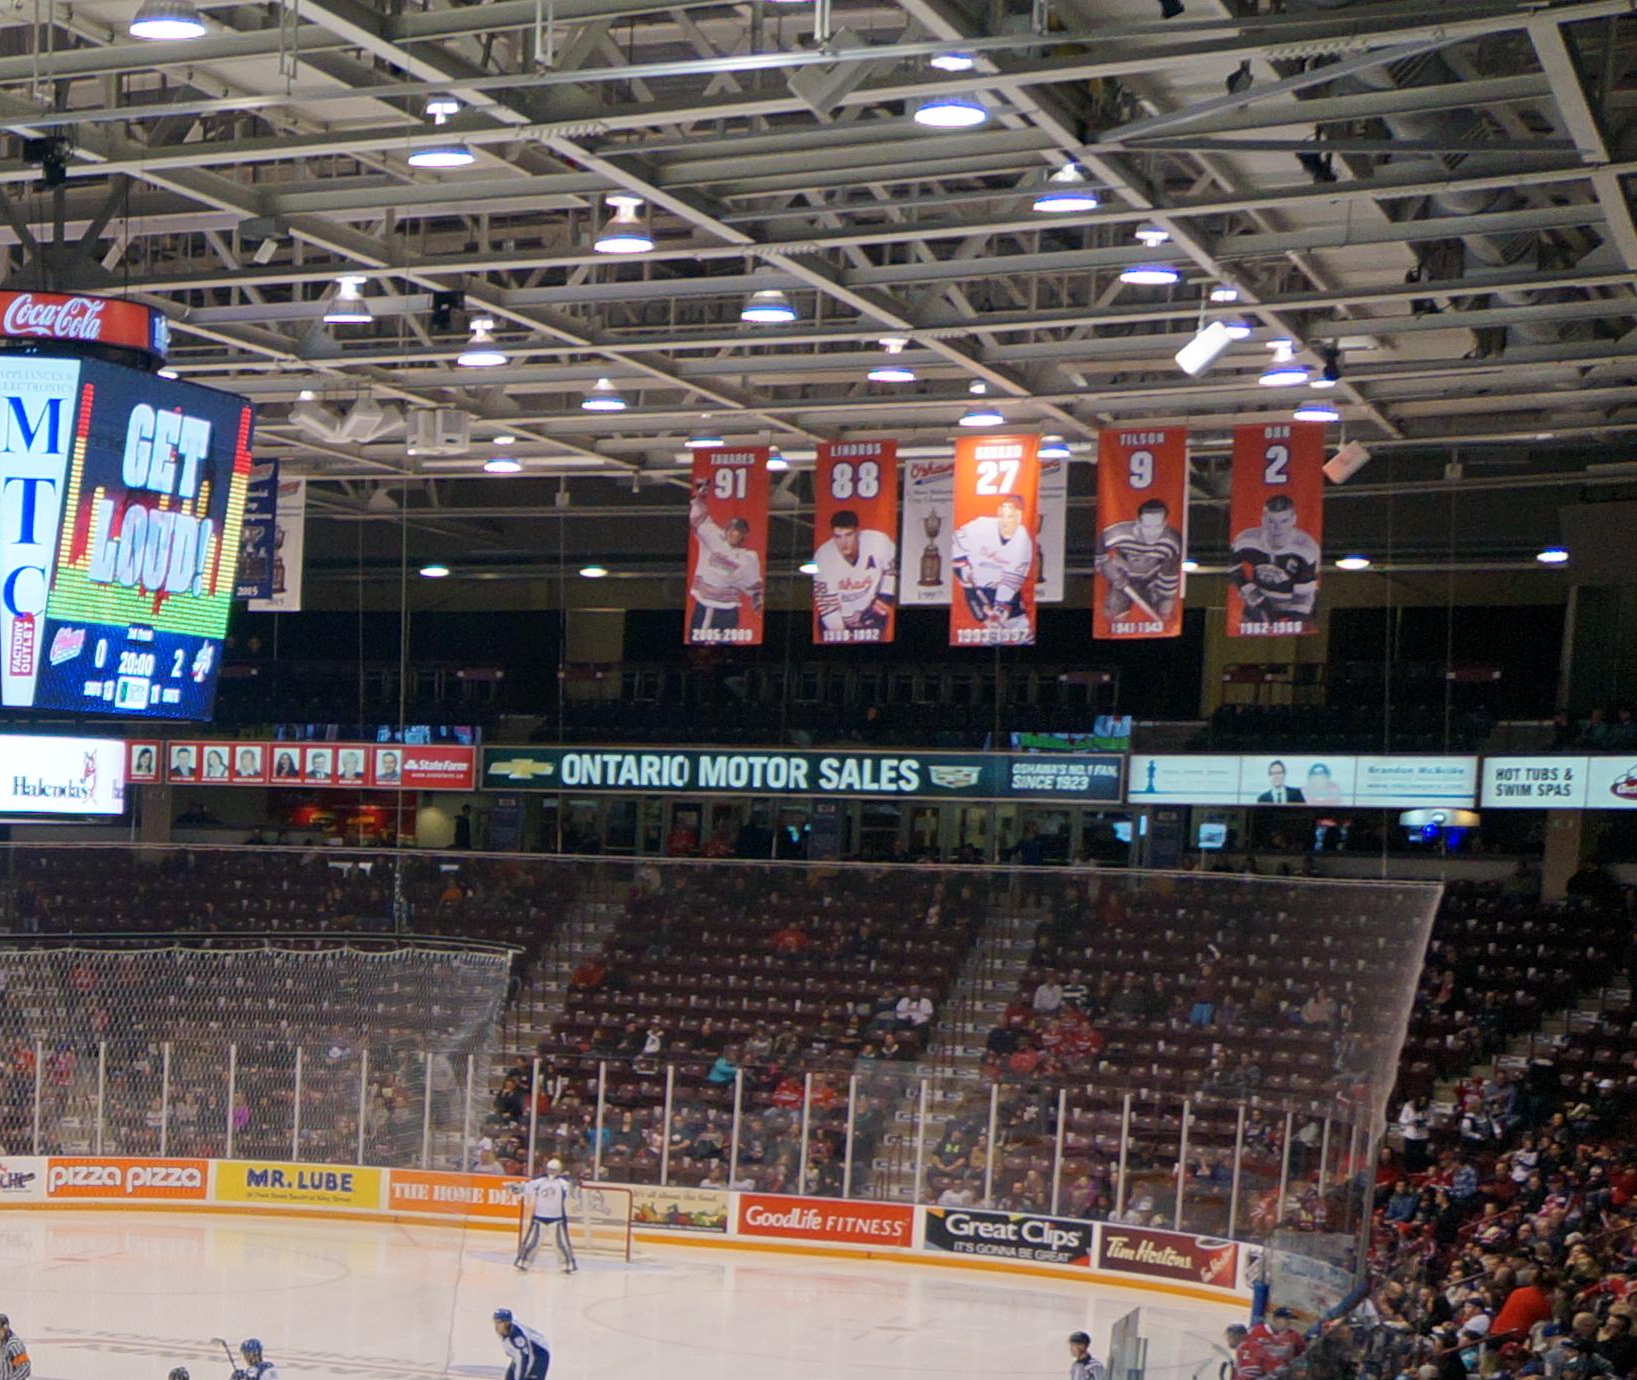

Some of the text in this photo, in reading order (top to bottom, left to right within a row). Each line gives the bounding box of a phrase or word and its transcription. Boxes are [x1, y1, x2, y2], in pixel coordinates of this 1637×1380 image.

[122, 402, 212, 498] GET
[830, 443, 881, 457] LINDROS
[1120, 432, 1165, 446] TILSON
[710, 453, 755, 465] TAVARES
[1129, 450, 1153, 489] 9
[1264, 445, 1288, 484] 2
[714, 468, 747, 499] 91
[831, 461, 880, 499] 88
[976, 460, 1020, 495] 27
[88, 497, 214, 597] LOUD!
[12, 621, 23, 674] FACTORY
[22, 621, 33, 674] OUTLET
[95, 638, 108, 669] 0
[119, 651, 155, 677] 20:00
[170, 649, 184, 678] 2
[562, 753, 920, 792] ONTARIO MOTOR SALES
[1012, 763, 1067, 775] OSHAWA'S
[1012, 775, 1090, 791] SINCE 1923
[1495, 767, 1573, 782] HOT TUBS &
[12, 776, 89, 799] Halenda's
[1495, 783, 1572, 797] SWIM SPAS
[48, 1166, 202, 1193] pizza pizza
[246, 1167, 353, 1193] MR. LUBE
[392, 1182, 428, 1199] THE
[433, 1185, 483, 1204] HOME
[745, 1206, 903, 1237] GoodLife FITNESS
[945, 1213, 1080, 1251] Great Clips
[953, 1242, 1072, 1262] IT'S GONNA BE GREAT
[1107, 1235, 1135, 1261] Tim
[1136, 1242, 1193, 1270] Hortons
